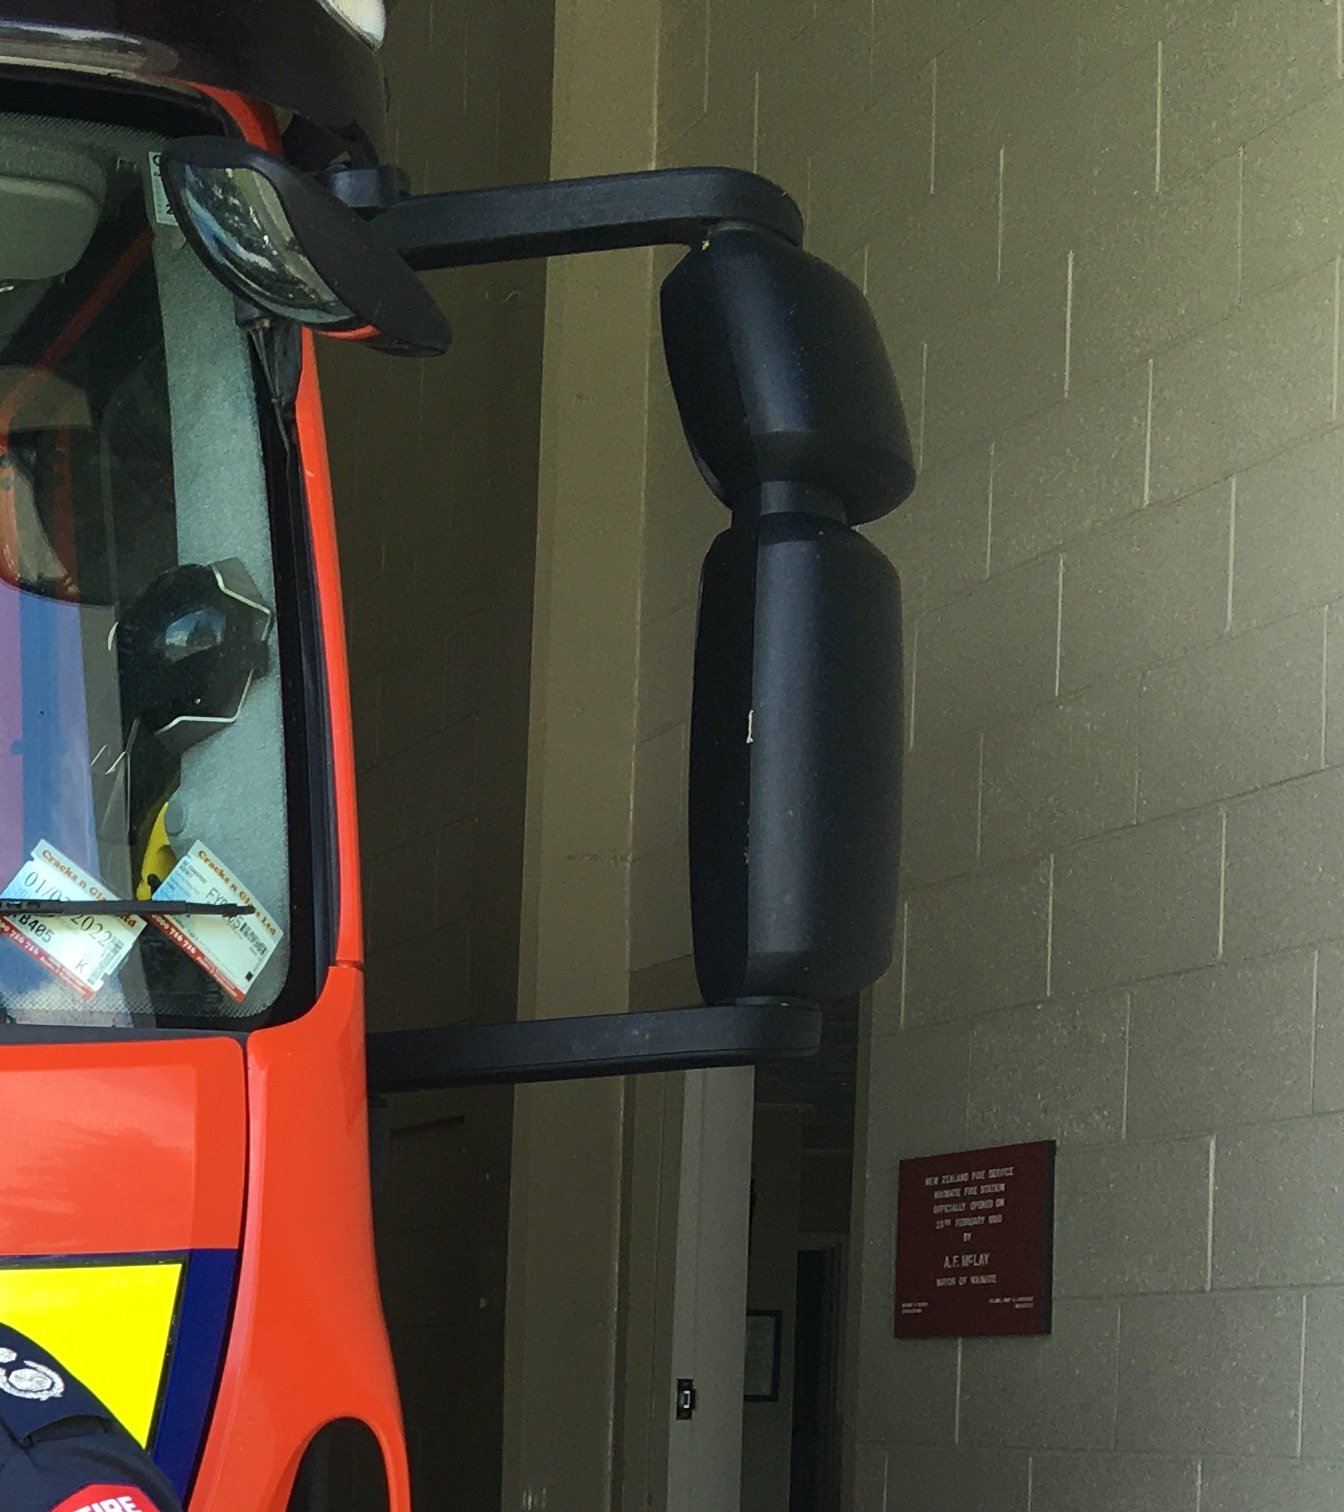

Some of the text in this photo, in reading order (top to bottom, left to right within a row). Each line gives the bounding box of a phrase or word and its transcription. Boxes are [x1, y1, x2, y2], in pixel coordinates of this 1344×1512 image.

[42, 849, 78, 882] Cracks
[79, 880, 87, 888] n
[198, 850, 230, 882] Cracks
[261, 917, 277, 936] Ltd
[963, 1232, 972, 1241] BY
